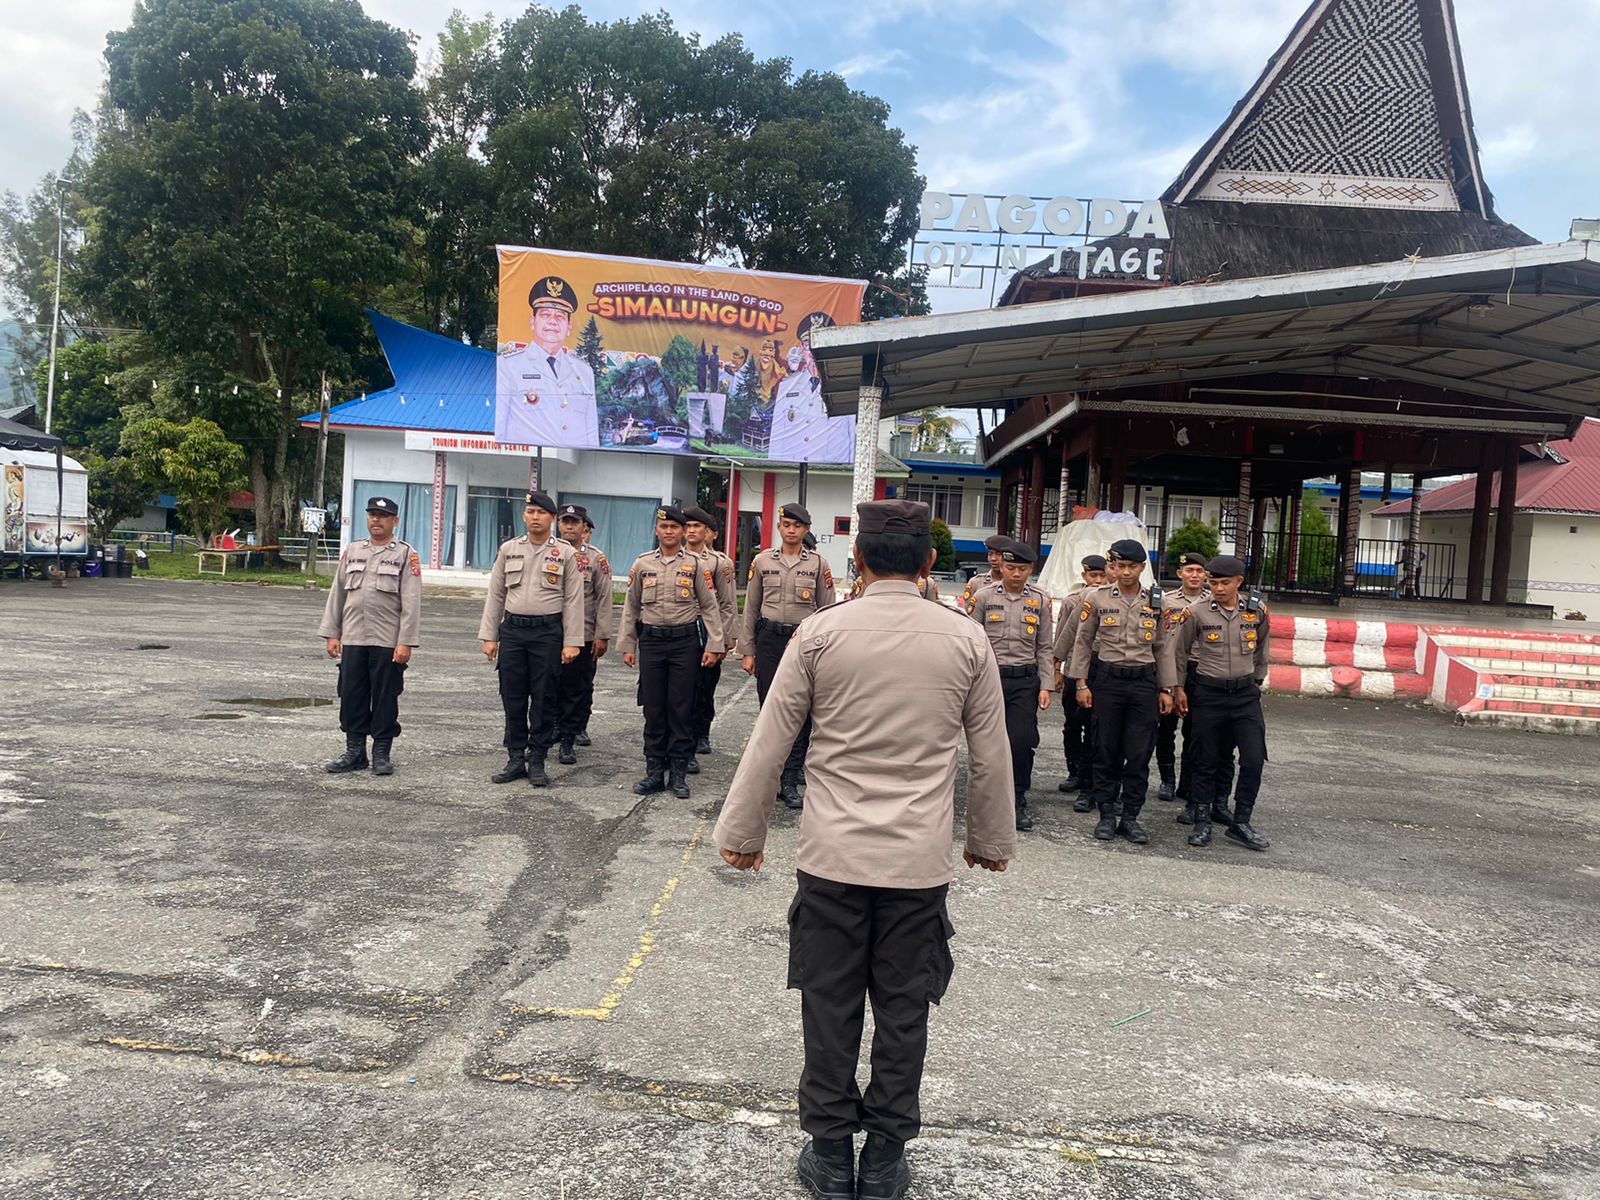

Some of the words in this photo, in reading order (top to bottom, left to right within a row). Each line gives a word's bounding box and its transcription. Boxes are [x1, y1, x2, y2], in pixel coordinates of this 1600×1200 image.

[920, 191, 1170, 239] PAGODA
[924, 241, 1027, 278] OPN
[595, 283, 671, 294] ARCHIPELAGO
[673, 285, 685, 295] IN
[688, 287, 708, 297] THE
[711, 290, 740, 302] LAND
[742, 295, 758, 305] OF
[759, 299, 782, 312] GOD
[432, 437, 458, 449] TOURISM
[460, 440, 501, 453] INFORMATION
[504, 444, 529, 453] CENTER
